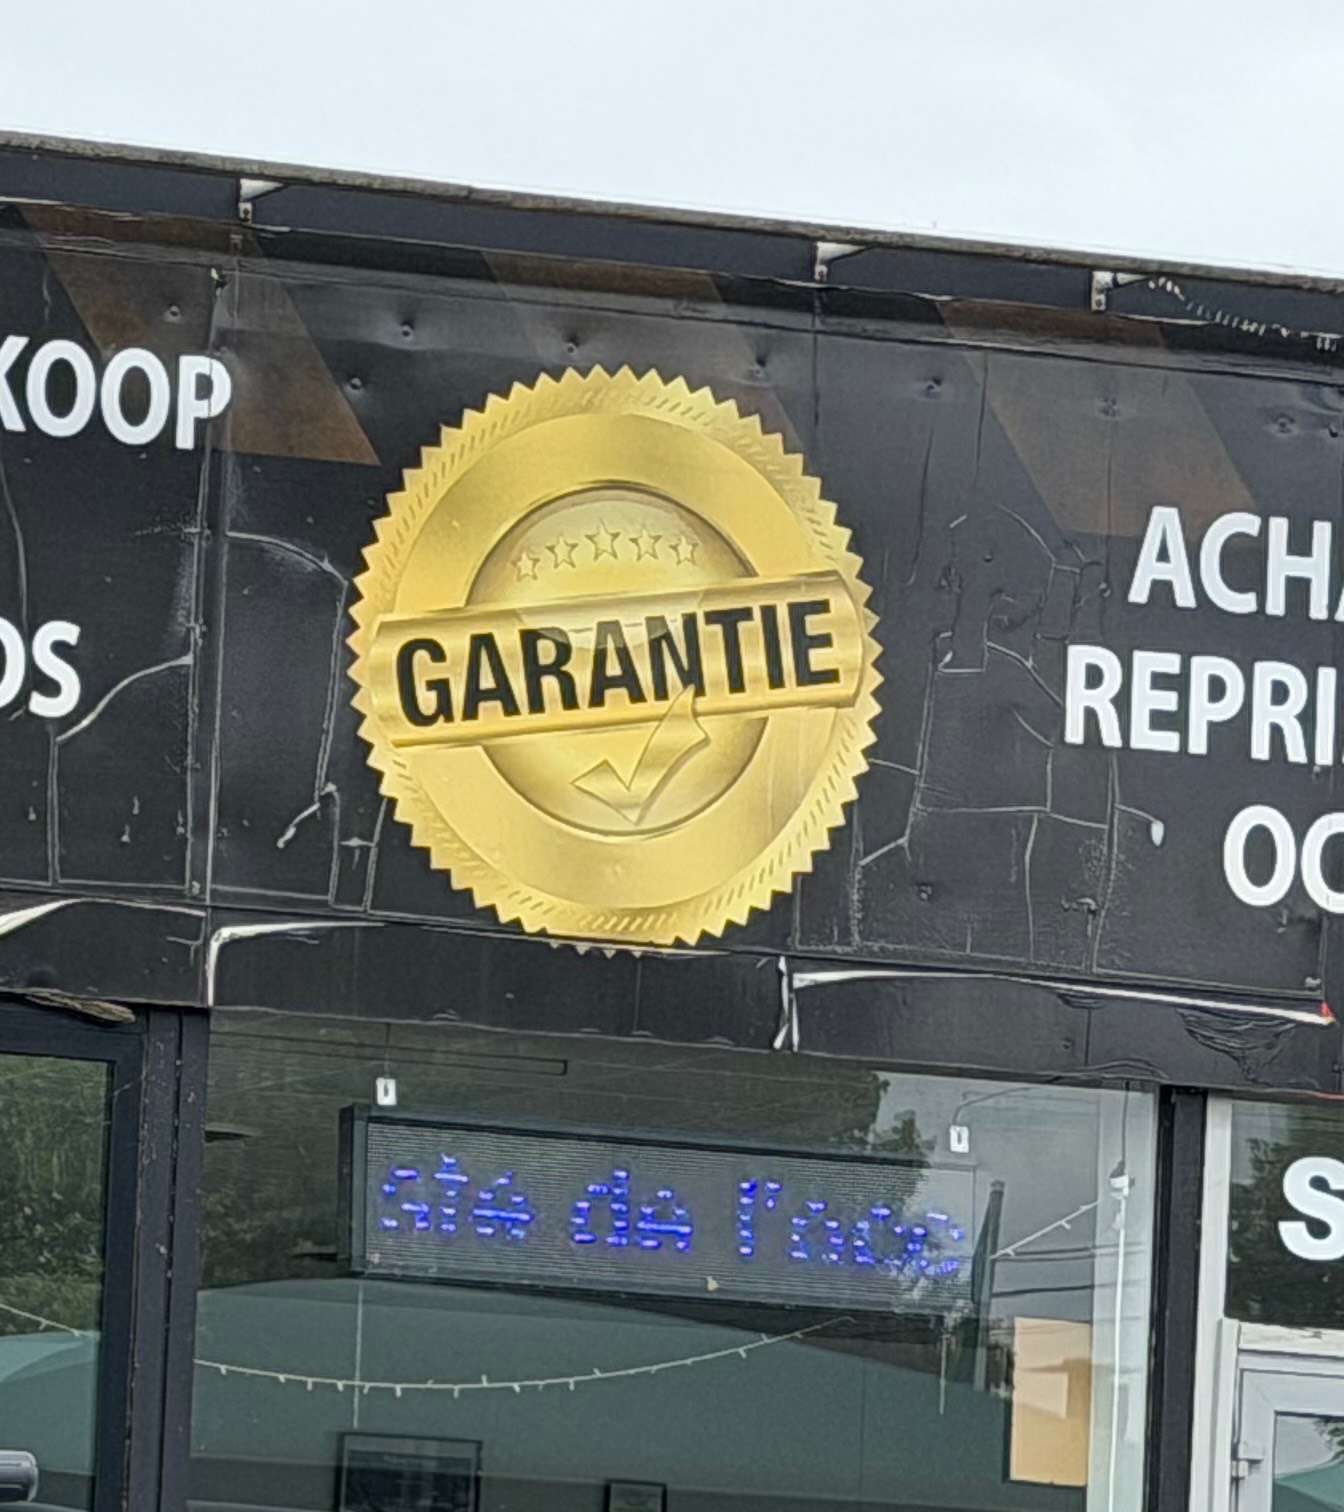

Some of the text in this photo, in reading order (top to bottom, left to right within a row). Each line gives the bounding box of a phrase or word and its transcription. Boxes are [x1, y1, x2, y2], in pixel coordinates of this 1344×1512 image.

[1127, 505, 1344, 621] ACH
[395, 598, 841, 728] GARANTIE
[1064, 644, 1344, 766] REPRI
